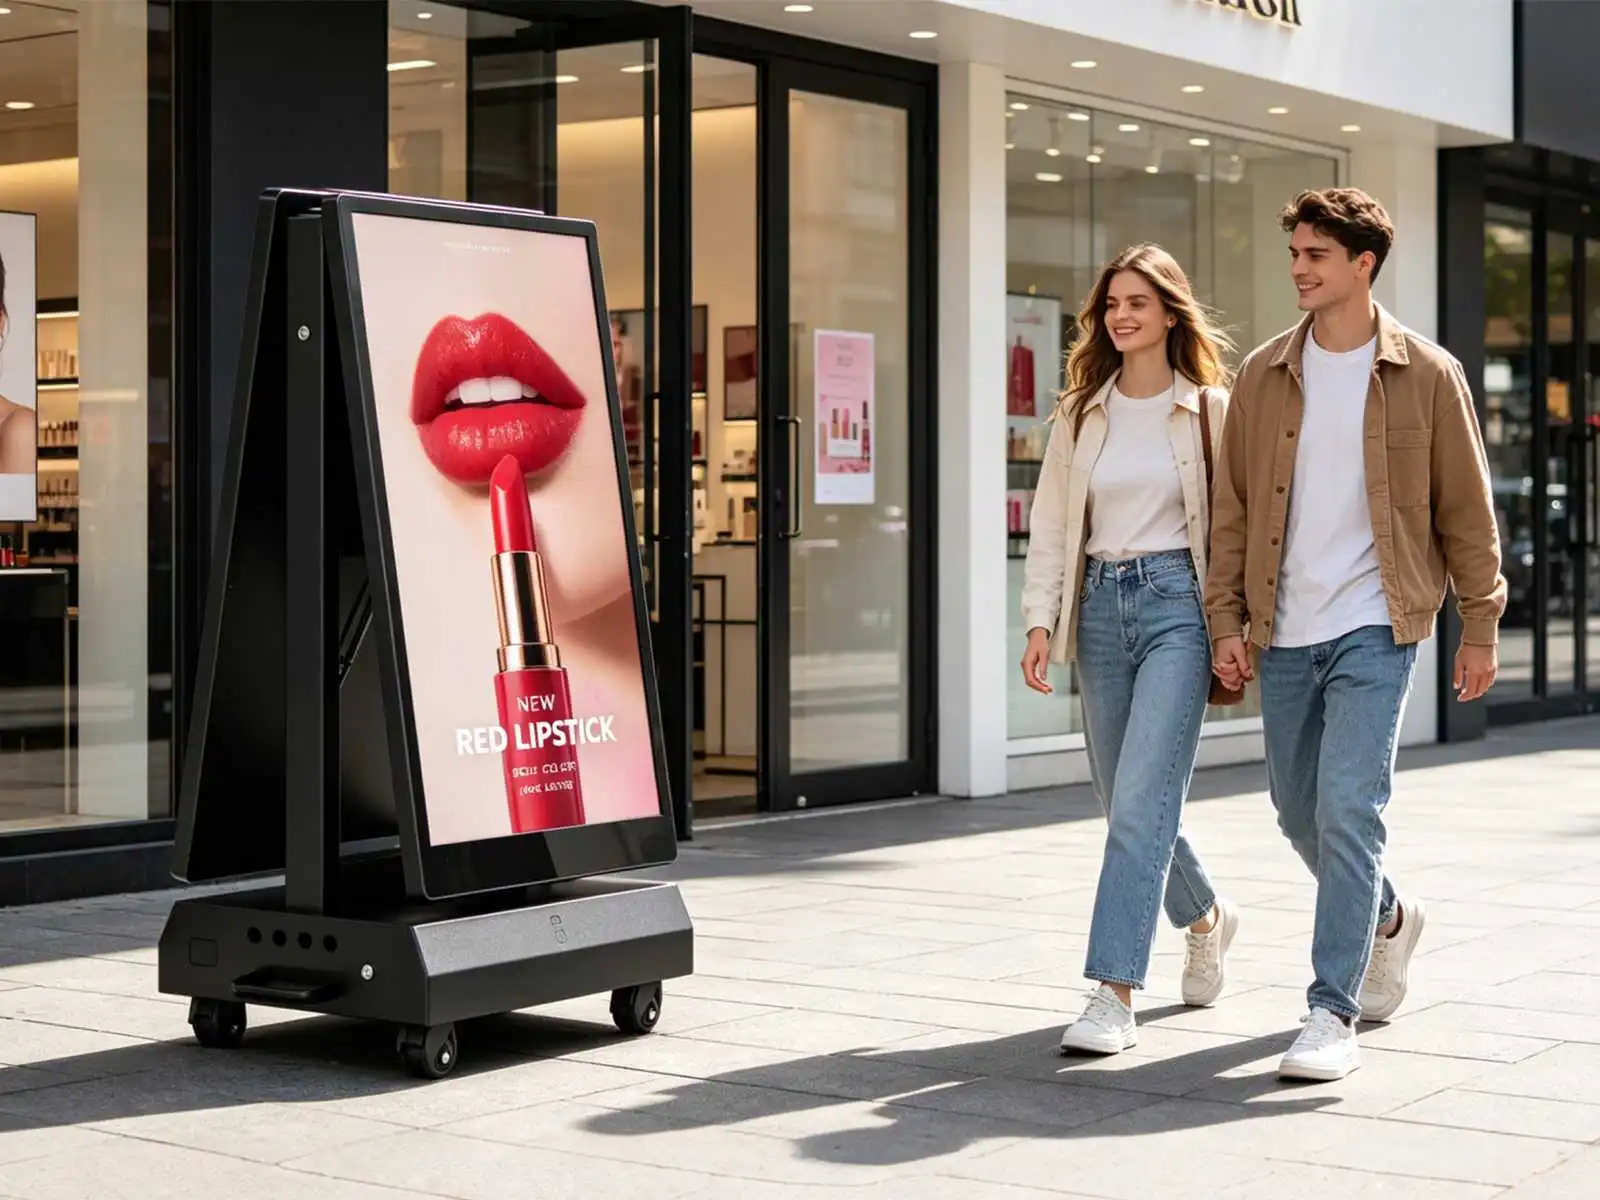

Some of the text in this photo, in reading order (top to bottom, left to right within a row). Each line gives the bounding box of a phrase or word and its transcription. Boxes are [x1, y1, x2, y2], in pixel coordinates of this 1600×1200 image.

[516, 694, 556, 712] NEW
[455, 715, 618, 756] RED LIPSTICK
